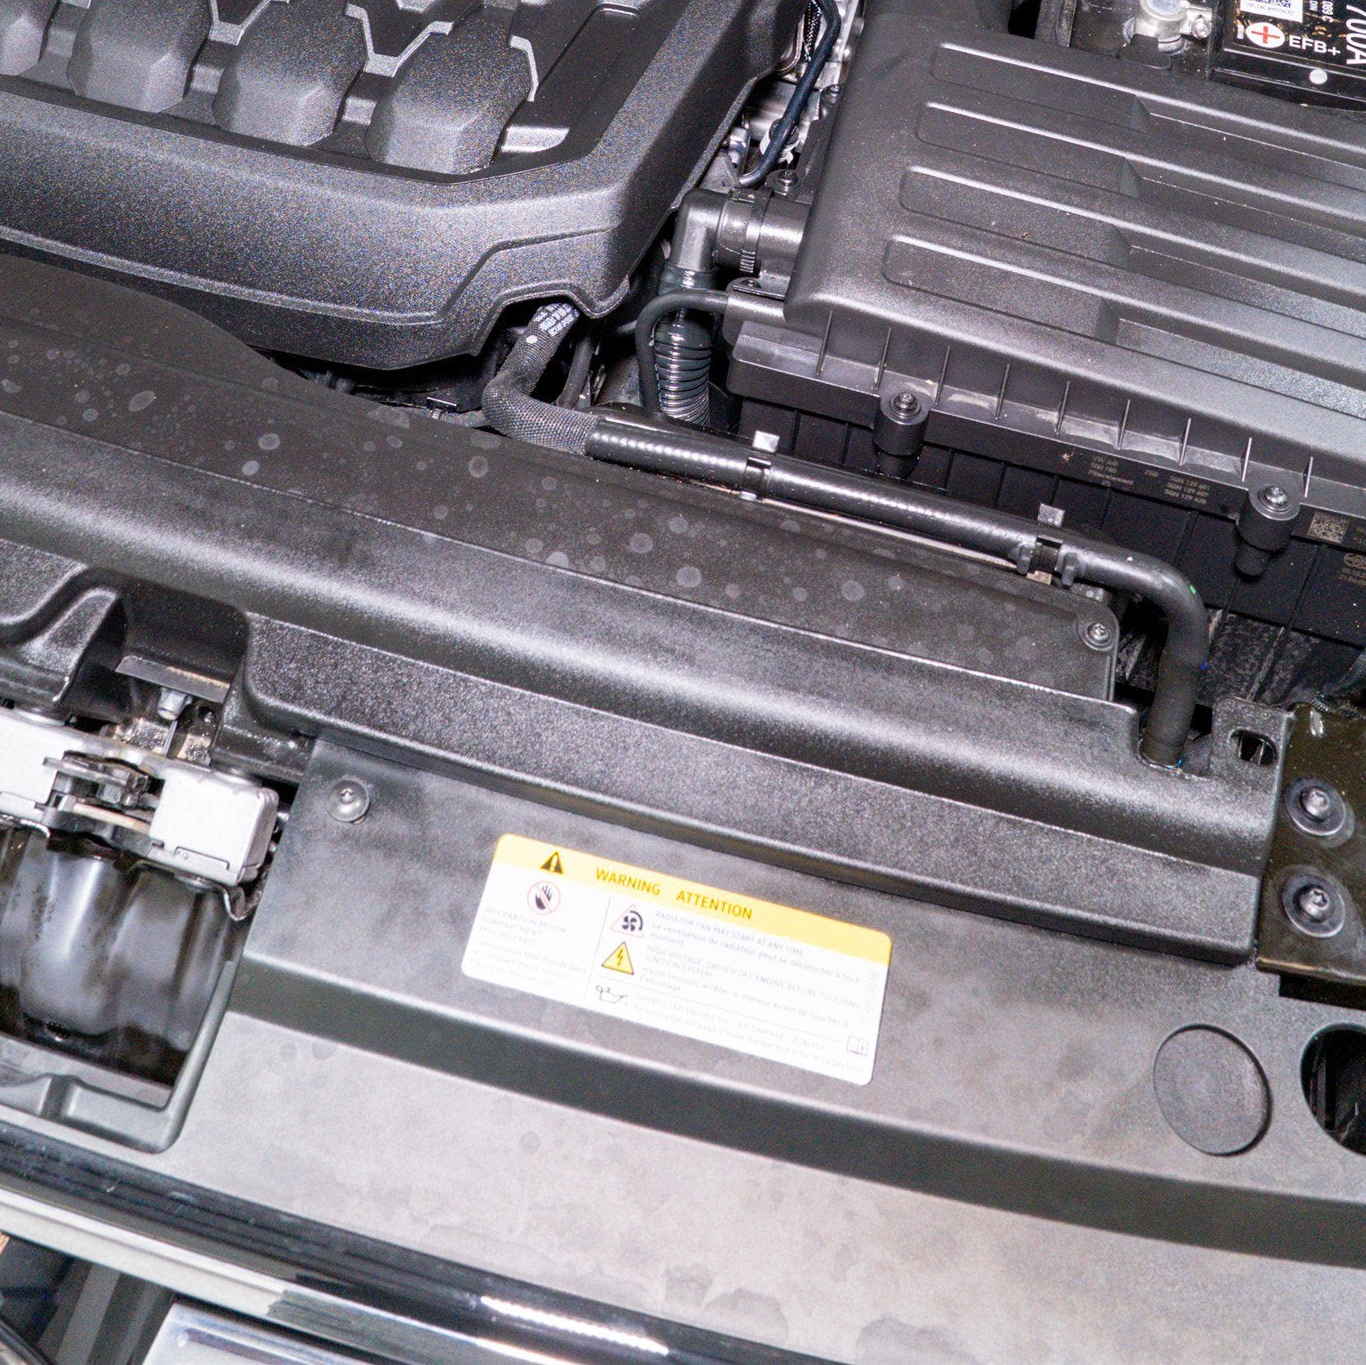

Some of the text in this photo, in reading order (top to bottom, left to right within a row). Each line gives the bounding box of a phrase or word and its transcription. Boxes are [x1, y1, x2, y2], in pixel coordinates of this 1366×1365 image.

[1321, 0, 1333, 15] 089
[1321, 15, 1332, 23] C
[1289, 34, 1341, 57] EFB+
[594, 868, 752, 919] WARNING ATTENTION
[655, 911, 693, 926] RADIATOR
[694, 921, 711, 931] FAN
[713, 926, 730, 936] MAY
[731, 931, 754, 942] START
[756, 937, 766, 946] AT
[767, 940, 783, 951] ANY
[645, 954, 679, 968] IGNITION
[664, 925, 706, 941] ventilateur
[708, 936, 718, 945] de
[720, 940, 755, 954] radiateur
[758, 950, 777, 962] peut
[842, 972, 859, 983] tout
[642, 965, 665, 977] Haute
[703, 982, 729, 994] arrêter
[741, 993, 770, 1006] moteur
[772, 1002, 795, 1013] avant
[646, 944, 668, 956] HIGH
[706, 961, 736, 974] SWITCH
[737, 969, 752, 979] OFF
[756, 975, 783, 987] ENGINE
[787, 983, 815, 996] BEFORE
[820, 992, 859, 1008] TOUCHING
